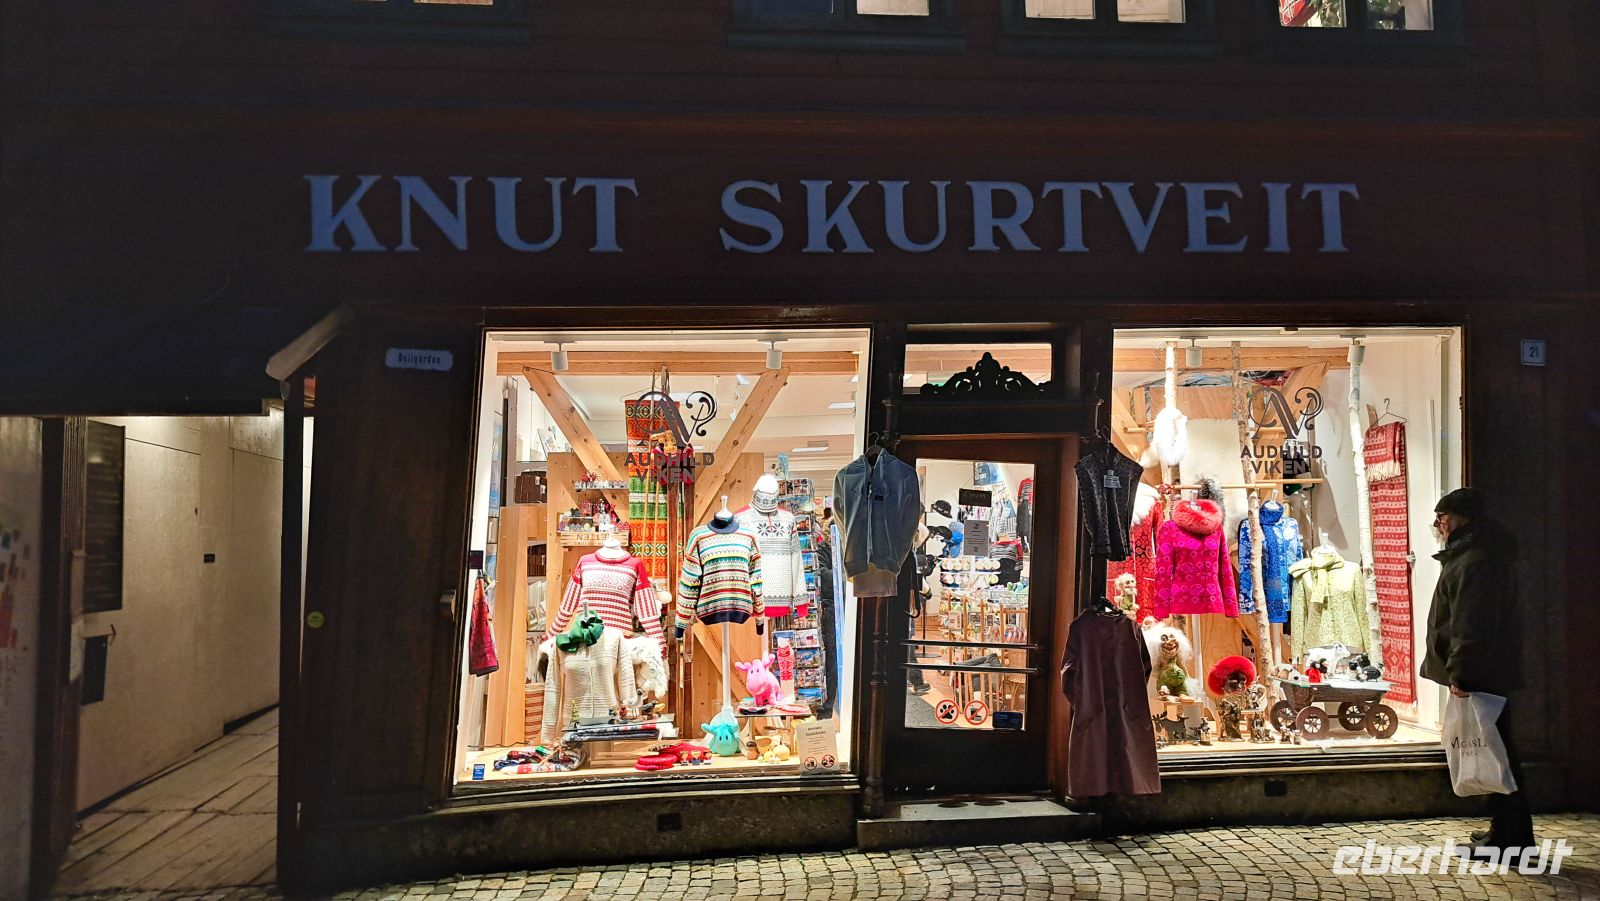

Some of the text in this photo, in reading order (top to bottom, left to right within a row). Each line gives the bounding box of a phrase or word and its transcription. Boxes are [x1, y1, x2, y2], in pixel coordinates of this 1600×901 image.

[303, 174, 1361, 254] KNUT SKURTVEIT
[1529, 345, 1539, 358] 21
[1240, 445, 1323, 459] AUDHILD
[624, 452, 715, 467] AUDHILD
[1251, 460, 1307, 474] VIKEN
[635, 468, 696, 483] VIKEN
